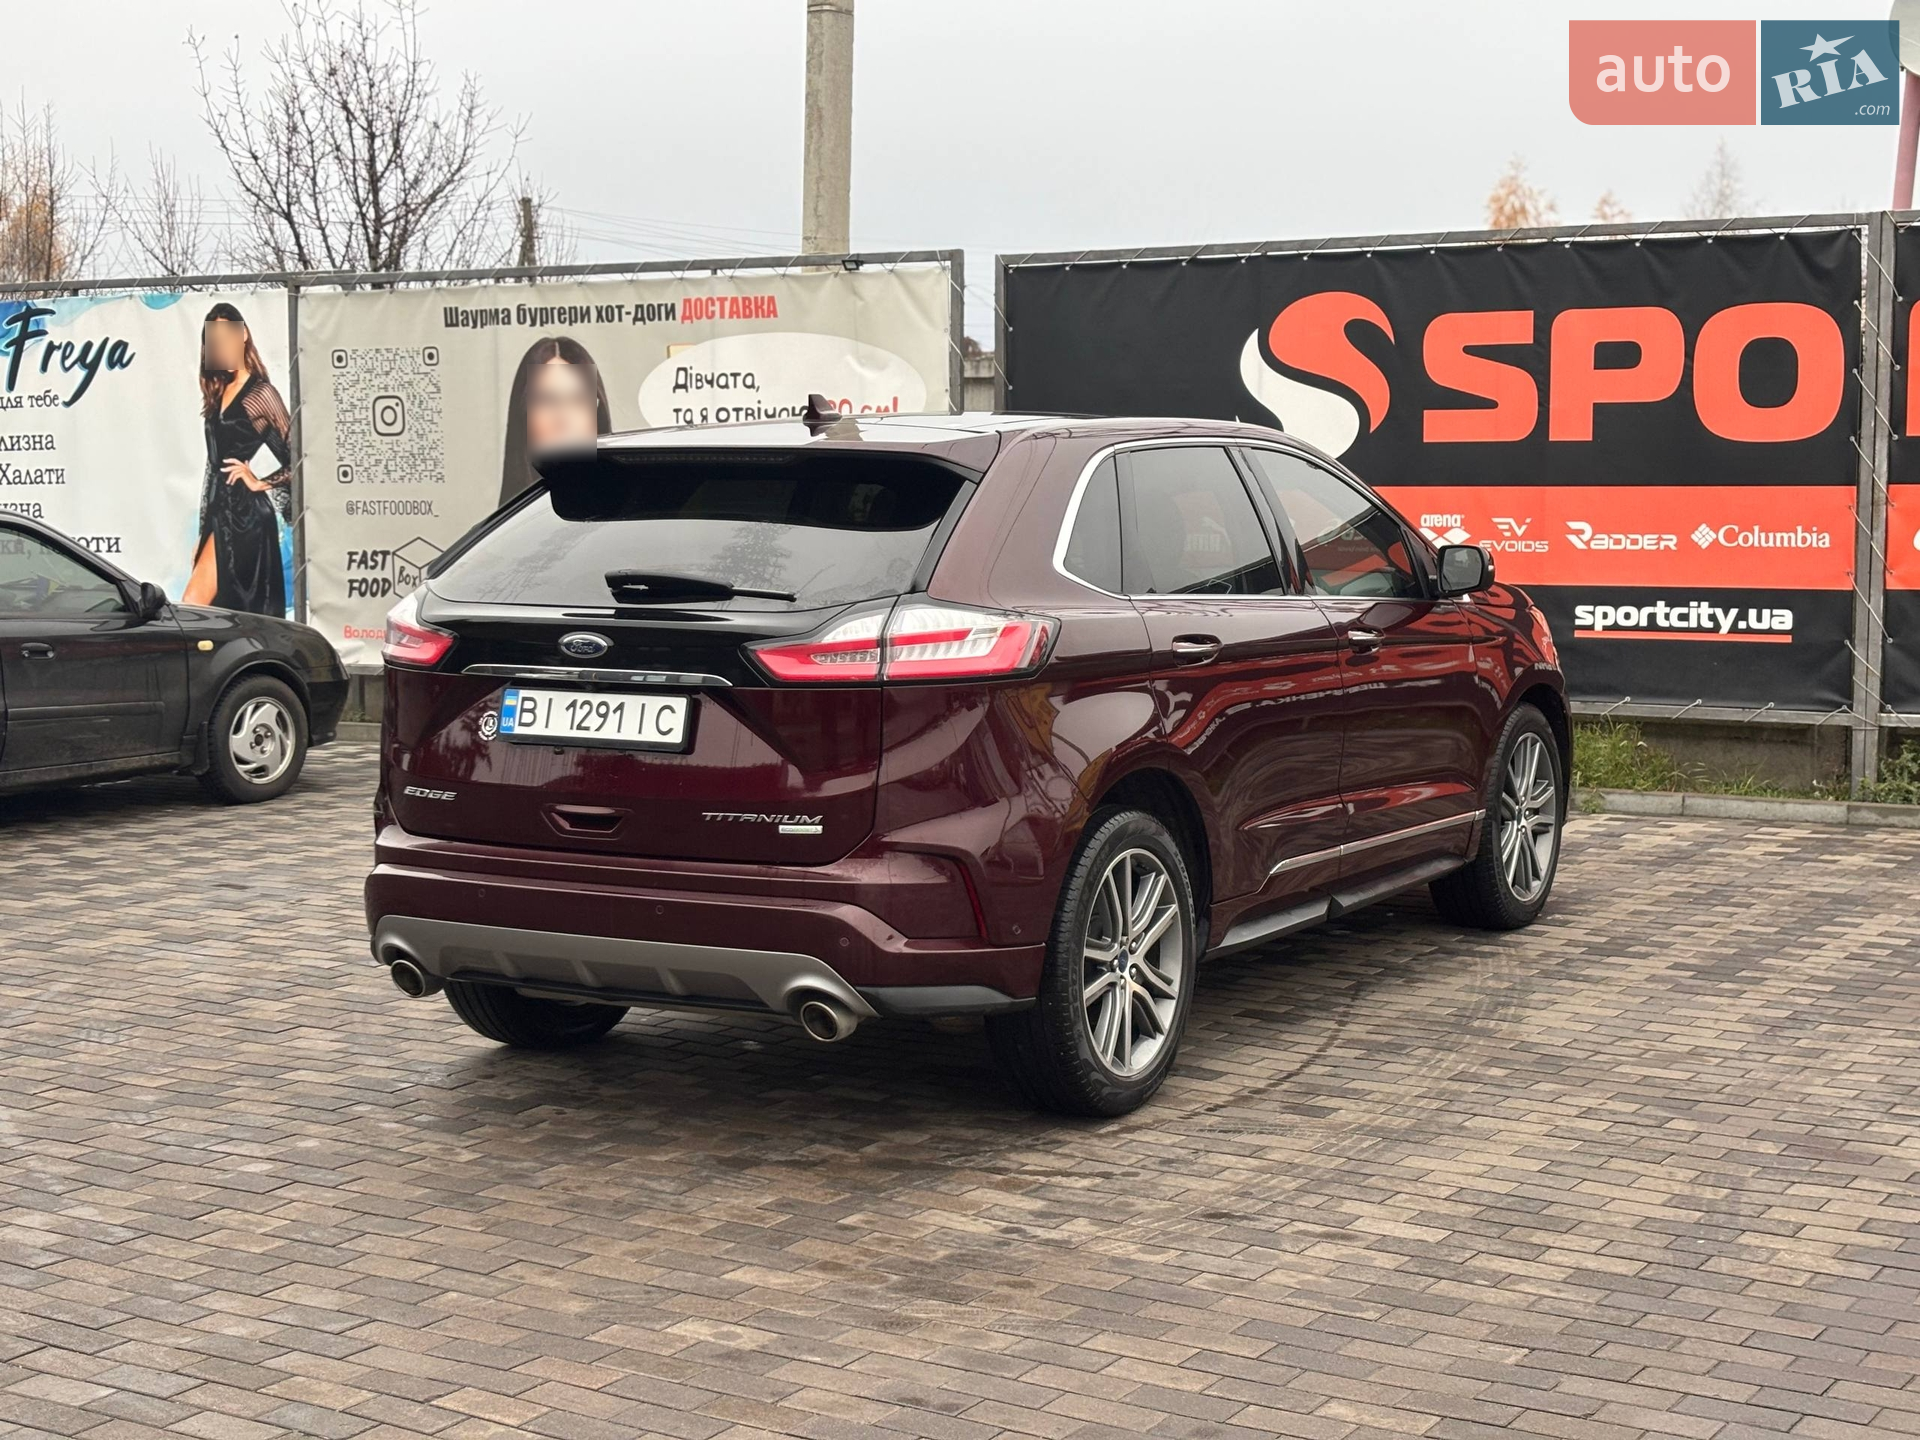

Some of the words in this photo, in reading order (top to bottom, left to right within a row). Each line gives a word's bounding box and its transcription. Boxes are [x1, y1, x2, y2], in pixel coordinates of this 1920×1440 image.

[443, 306, 512, 329] Шаурма
[516, 303, 592, 327] бургери
[595, 302, 677, 325] хот-доги
[681, 295, 778, 324] ДОСТАВКА
[3, 305, 136, 408] Freya
[672, 366, 761, 393] Дівчата,
[27, 389, 60, 408] тебе
[673, 407, 694, 424] та
[699, 407, 709, 424] я
[0, 463, 66, 485] Халати
[346, 500, 440, 517] @FASTFOODBOX_
[1420, 513, 1464, 528] arena
[1717, 524, 1831, 549] Columbia
[347, 549, 391, 571] FAST
[347, 577, 392, 599] FOOD
[1574, 600, 1793, 634] sportcity.ua
[502, 717, 514, 727] UA
[565, 699, 625, 733] 1291
[403, 786, 458, 800] EDGE
[702, 812, 823, 824] TITANIUM
